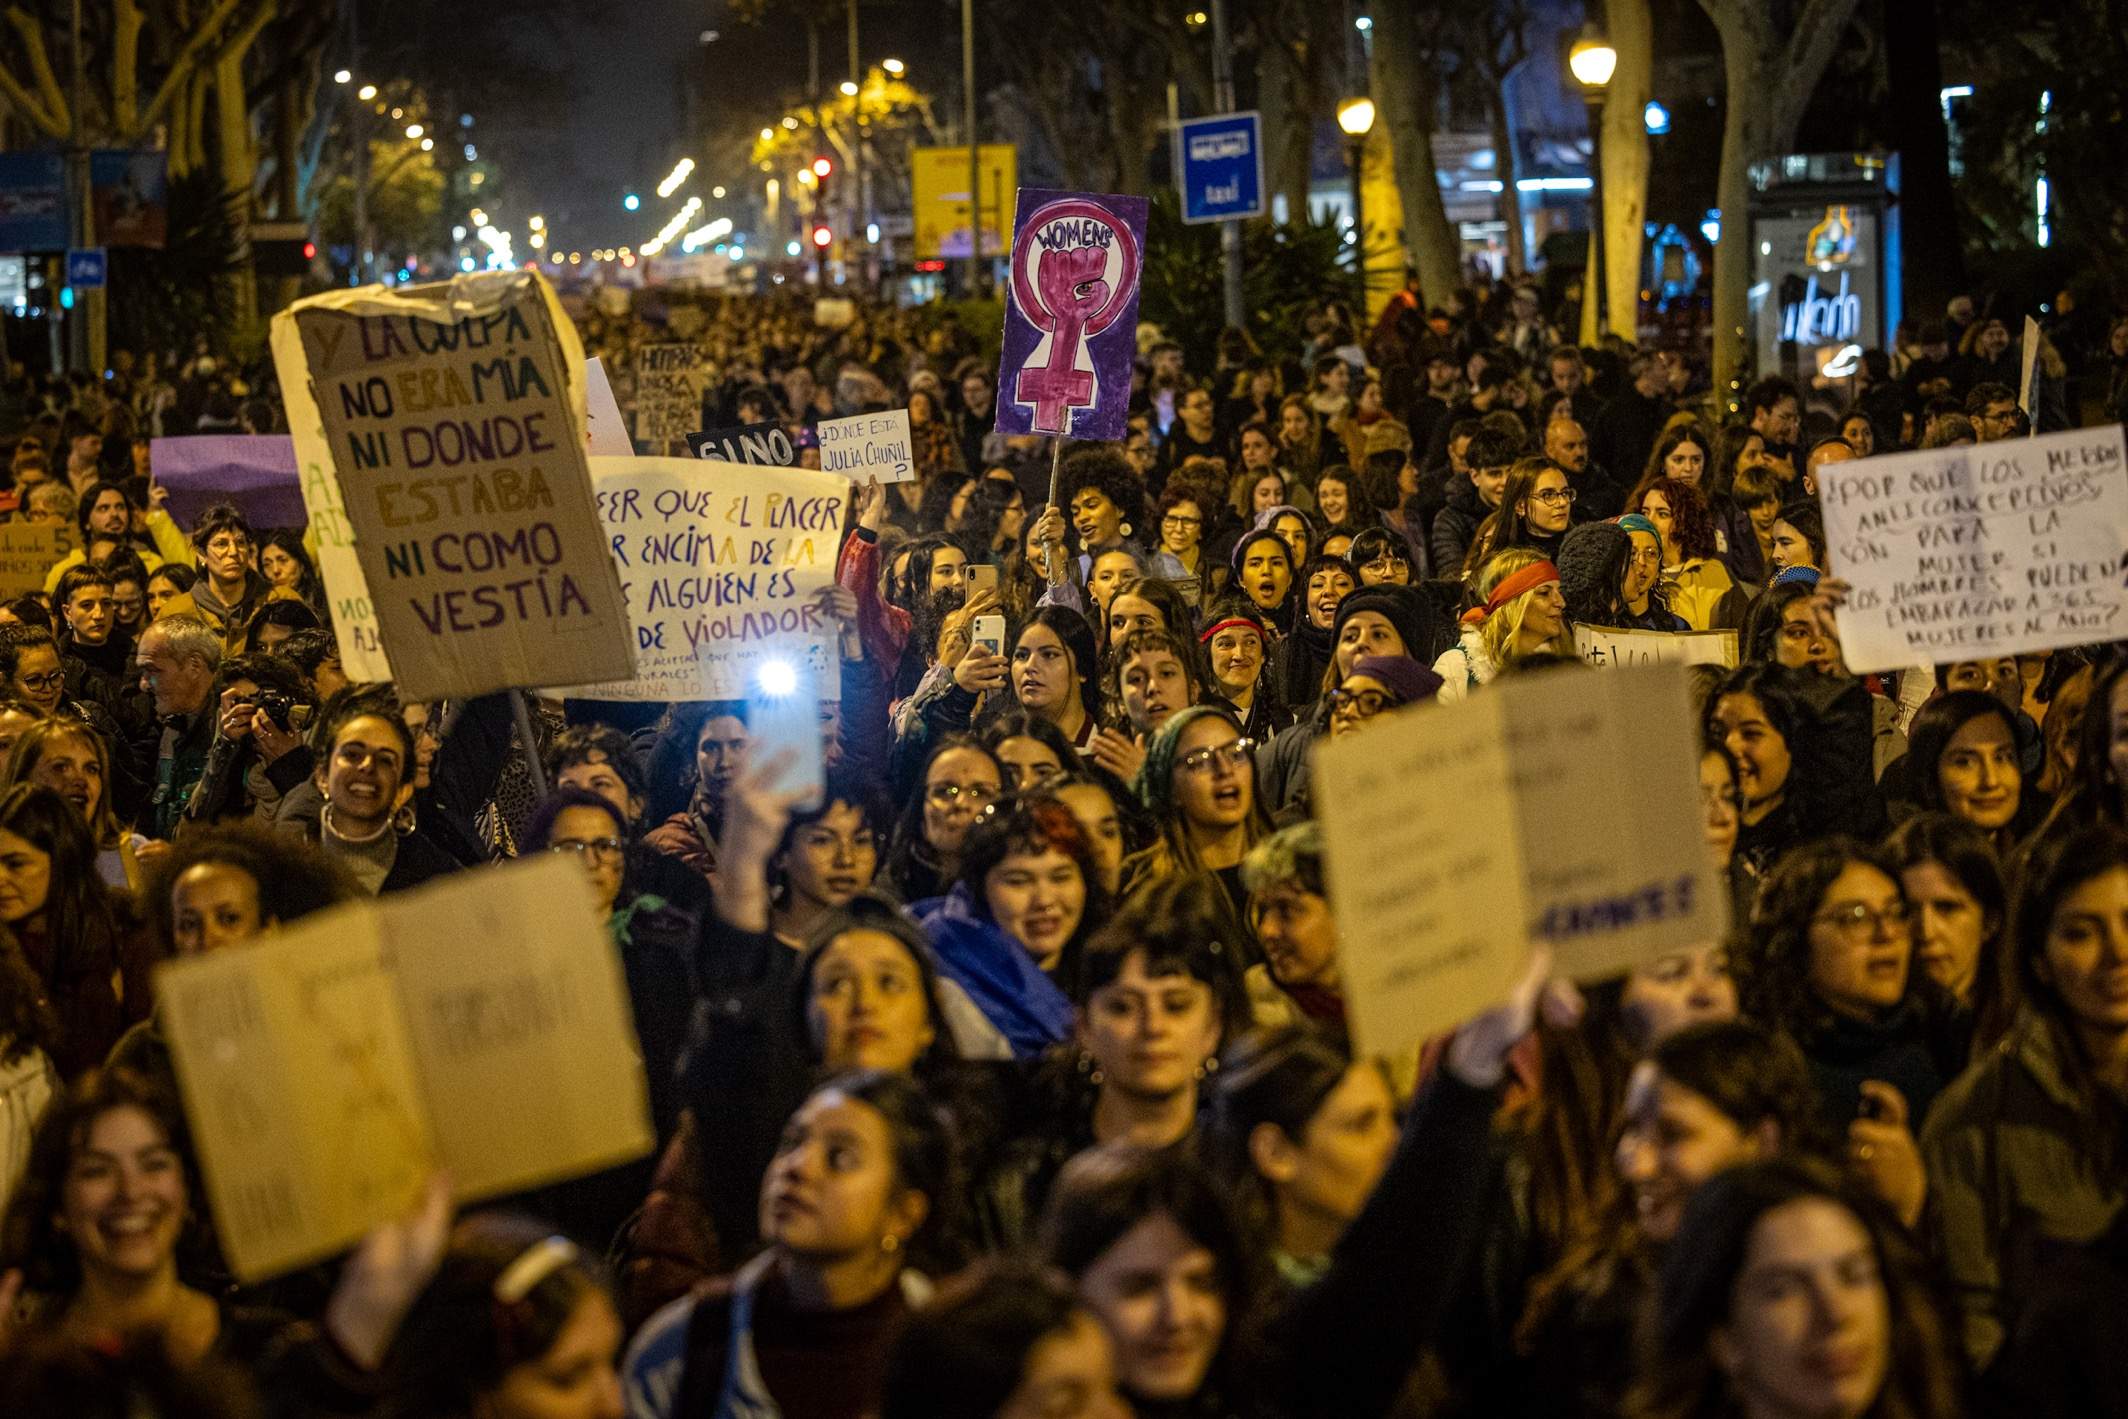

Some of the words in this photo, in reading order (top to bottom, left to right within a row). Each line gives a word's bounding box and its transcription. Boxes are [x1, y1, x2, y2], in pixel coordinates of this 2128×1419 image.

[1035, 219, 1113, 249] WOMENS
[313, 325, 345, 369] Y
[359, 316, 411, 361] LA
[340, 376, 394, 420] NO
[397, 367, 472, 413] ERA
[347, 431, 391, 470] NI
[401, 412, 555, 469] DONDE
[1981, 459, 2024, 484] LOS
[374, 465, 554, 528] ESTABA
[654, 489, 712, 523] QUE
[725, 495, 752, 528] EL
[763, 492, 843, 531] PLACER
[2029, 509, 2061, 536] LA
[383, 537, 427, 580] NI
[431, 522, 564, 575] COMO
[641, 525, 737, 568] ENCIMA
[750, 538, 775, 566] DE
[782, 537, 815, 566] LA
[410, 569, 593, 636] VESTÍA
[767, 568, 796, 599] ES
[2026, 591, 2040, 611] A
[638, 622, 667, 650] DE
